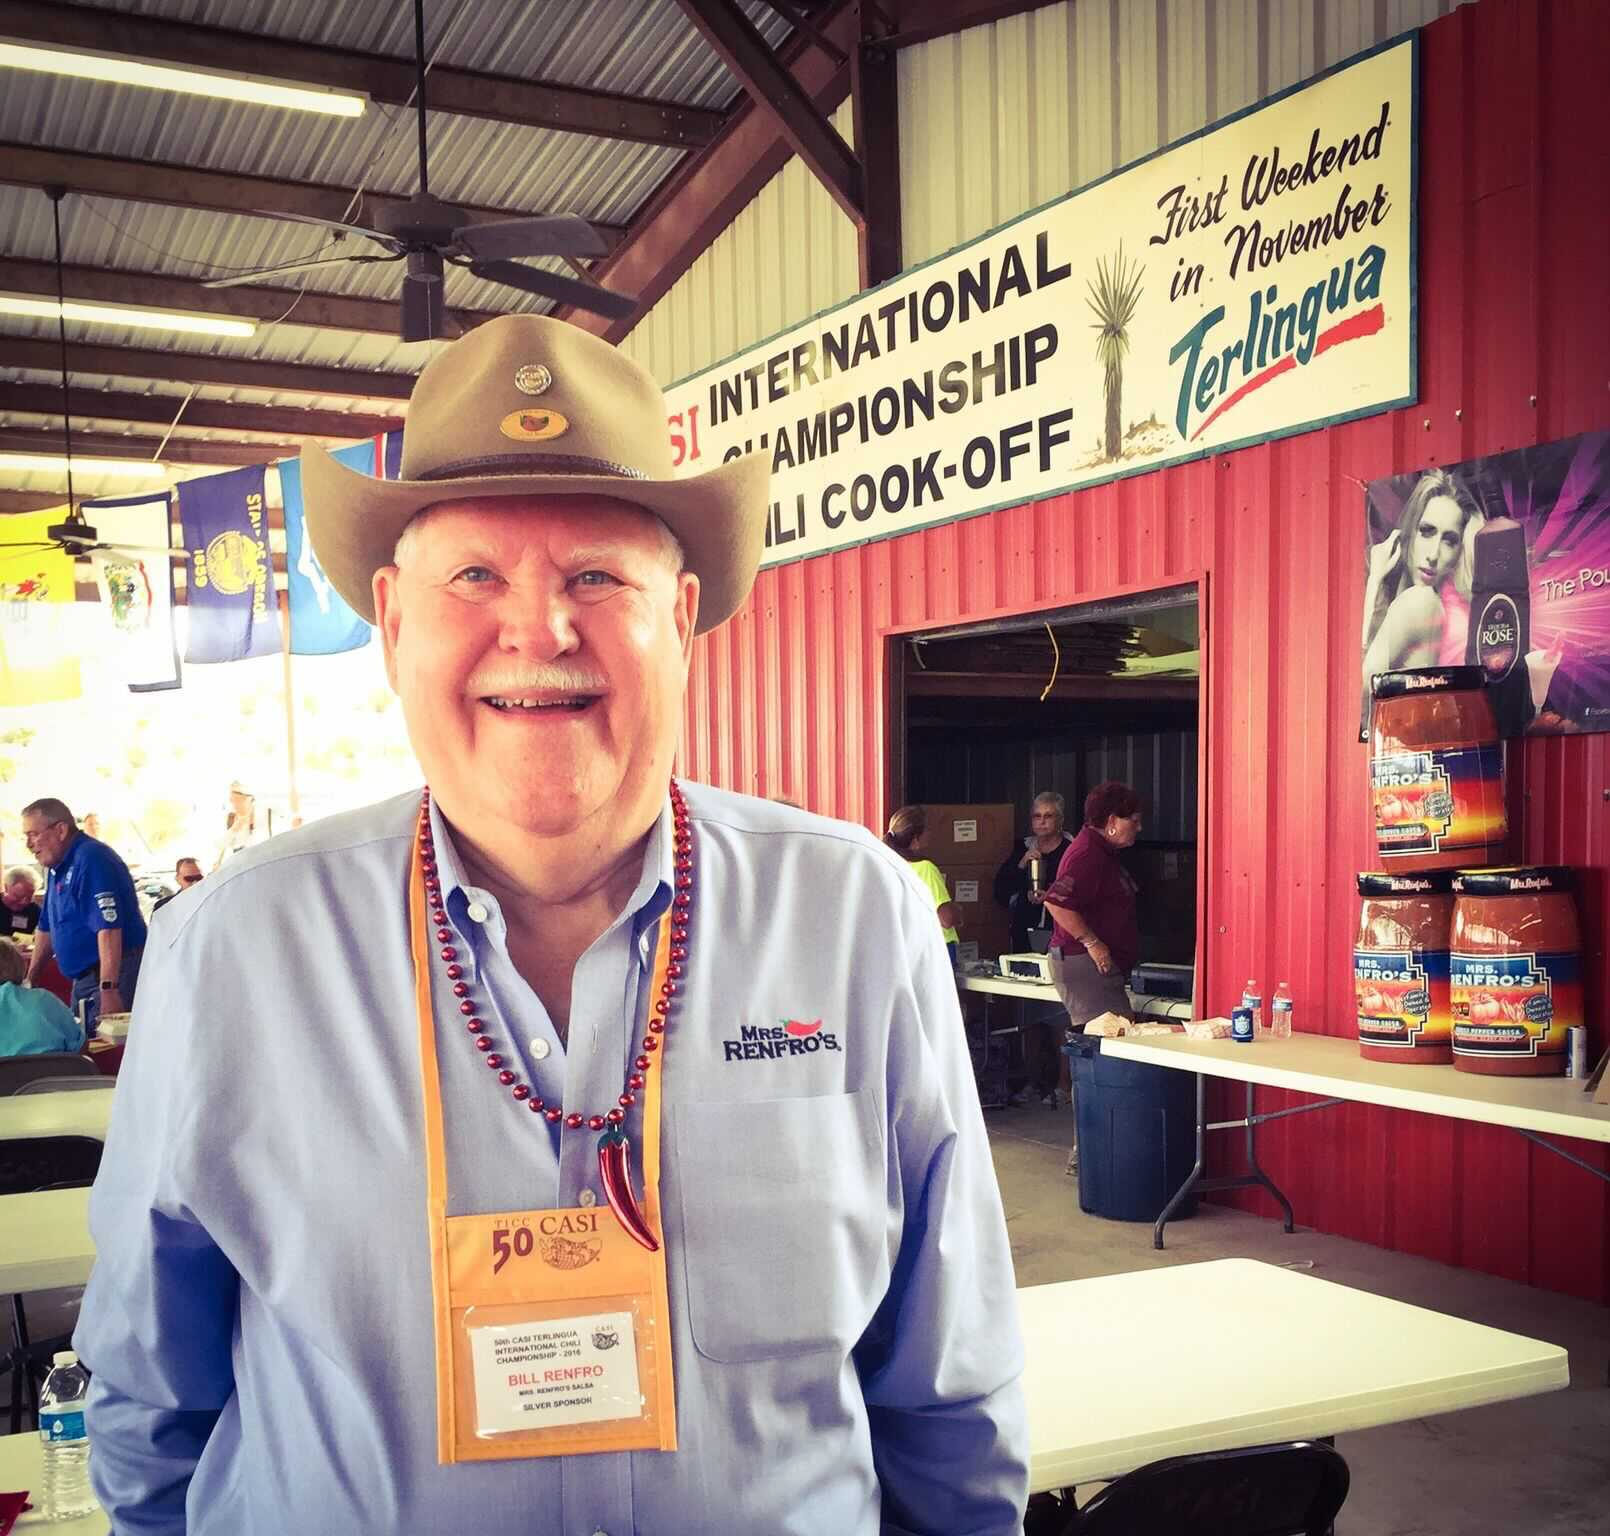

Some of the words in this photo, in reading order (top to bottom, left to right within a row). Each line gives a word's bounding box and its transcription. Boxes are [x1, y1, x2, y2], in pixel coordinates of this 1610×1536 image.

[1149, 173, 1229, 246] First
[1241, 101, 1391, 211] Weekend
[1170, 257, 1204, 302] in
[1224, 183, 1392, 280] November
[709, 230, 1072, 427] INTERNATIONAL
[1169, 244, 1386, 440] Terlingua
[668, 405, 701, 467] SI
[765, 493, 806, 548] ILI
[821, 407, 1074, 529] COOK-OFF
[1539, 578, 1576, 601] The
[1482, 628, 1514, 645] ROSE
[1465, 964, 1498, 974] MRS.
[540, 1213, 600, 1236] CASI
[493, 1227, 534, 1276] 50
[495, 1342, 558, 1356] INTERNATIONAL
[560, 1340, 581, 1348] CHILI
[512, 1335, 531, 1344] CASI
[533, 1330, 578, 1341] TERLINGUA
[496, 1352, 557, 1365] CHAMPIONSHIP
[508, 1373, 540, 1387] BILL
[544, 1365, 604, 1382] RENFRO
[523, 1402, 552, 1411] SILVER
[553, 1397, 593, 1408] SPONSOR
